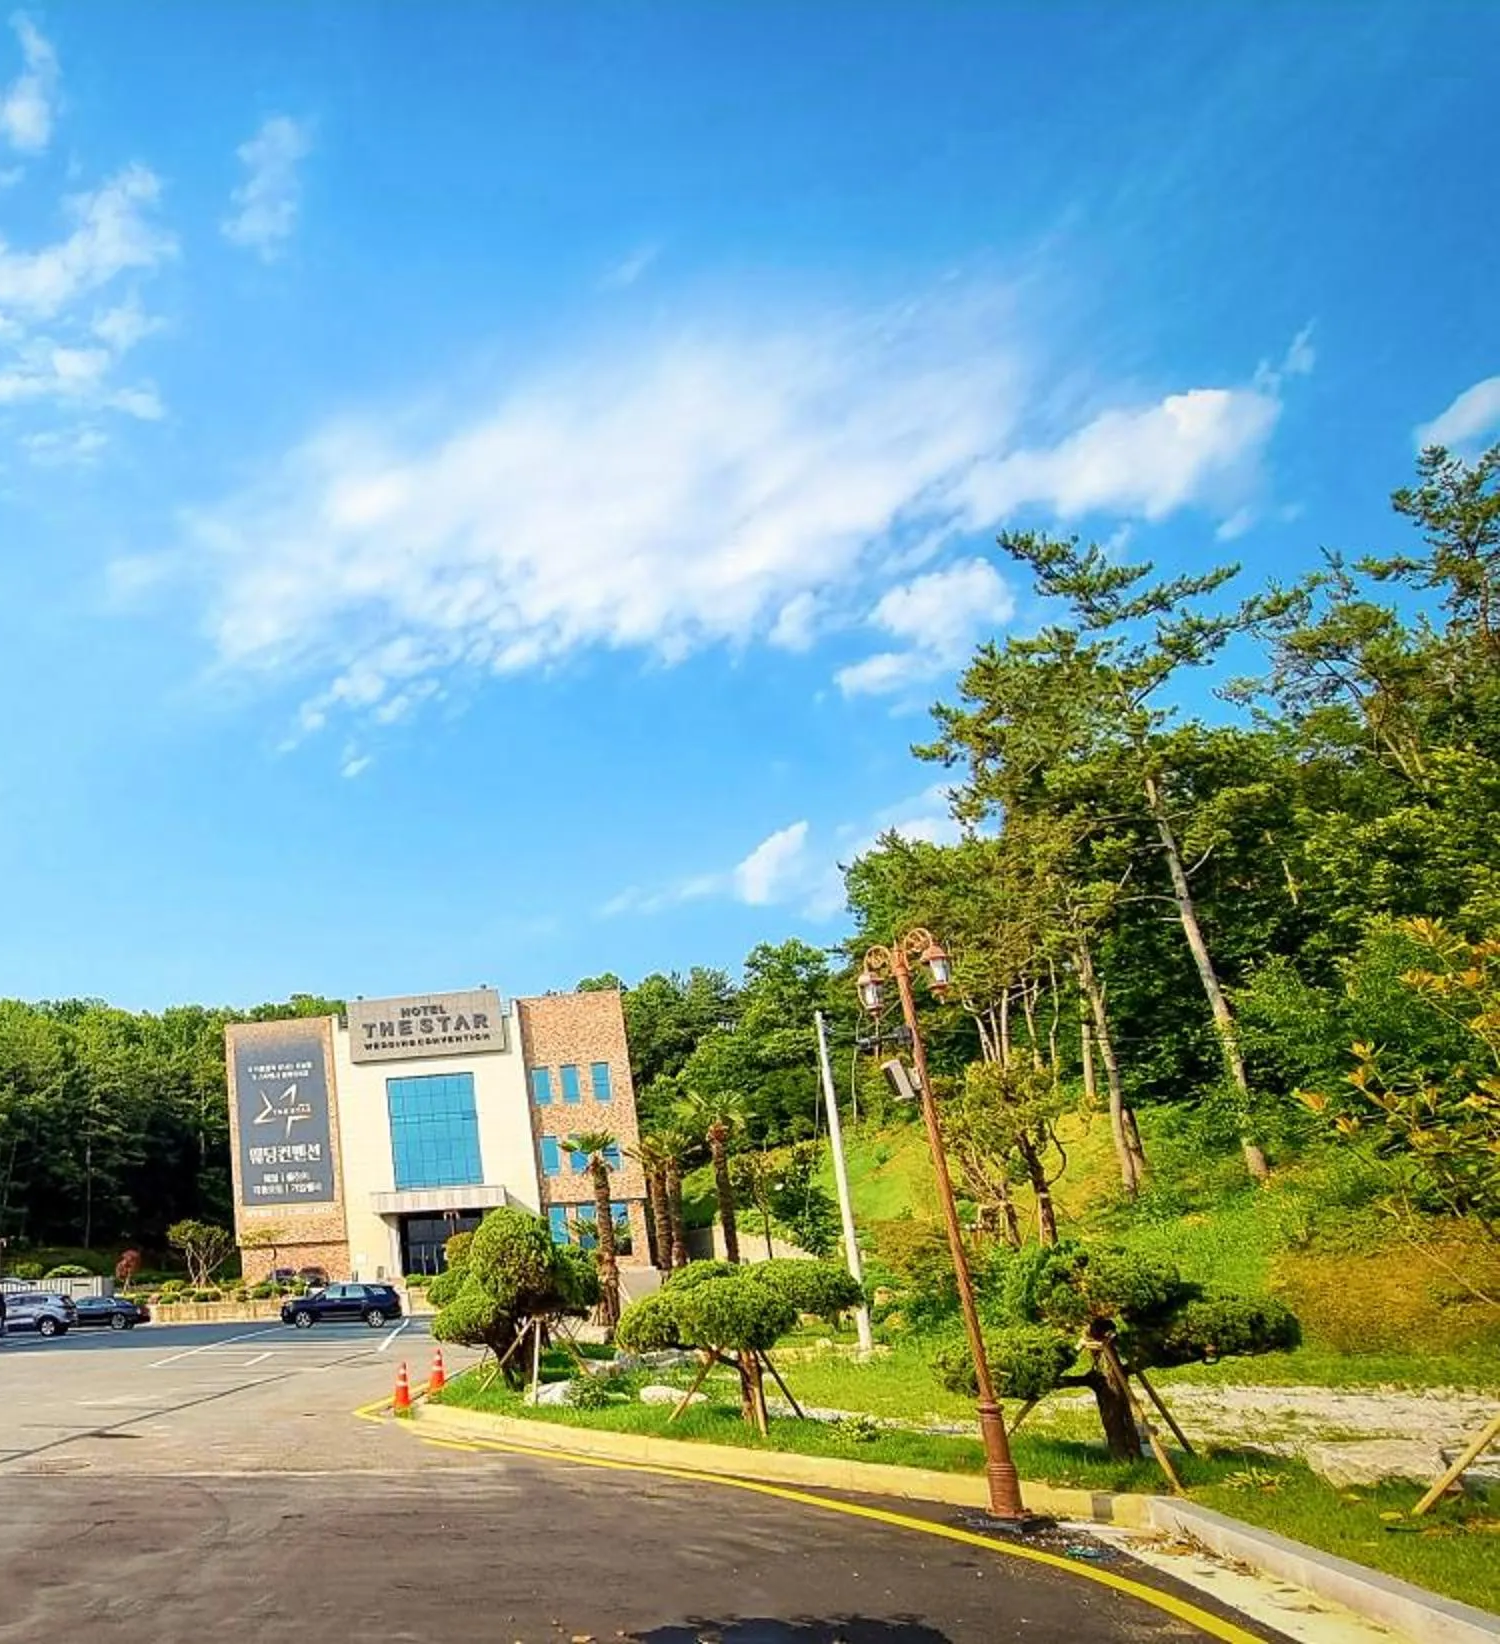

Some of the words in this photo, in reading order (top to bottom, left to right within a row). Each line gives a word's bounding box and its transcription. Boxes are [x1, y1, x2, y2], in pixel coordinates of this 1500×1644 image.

[401, 1004, 446, 1018] HOTEL
[362, 1019, 413, 1039] THE
[419, 1013, 489, 1034] STAR
[418, 1033, 490, 1046] CONVENTION
[249, 1143, 321, 1164] 웨딩컨벤션
